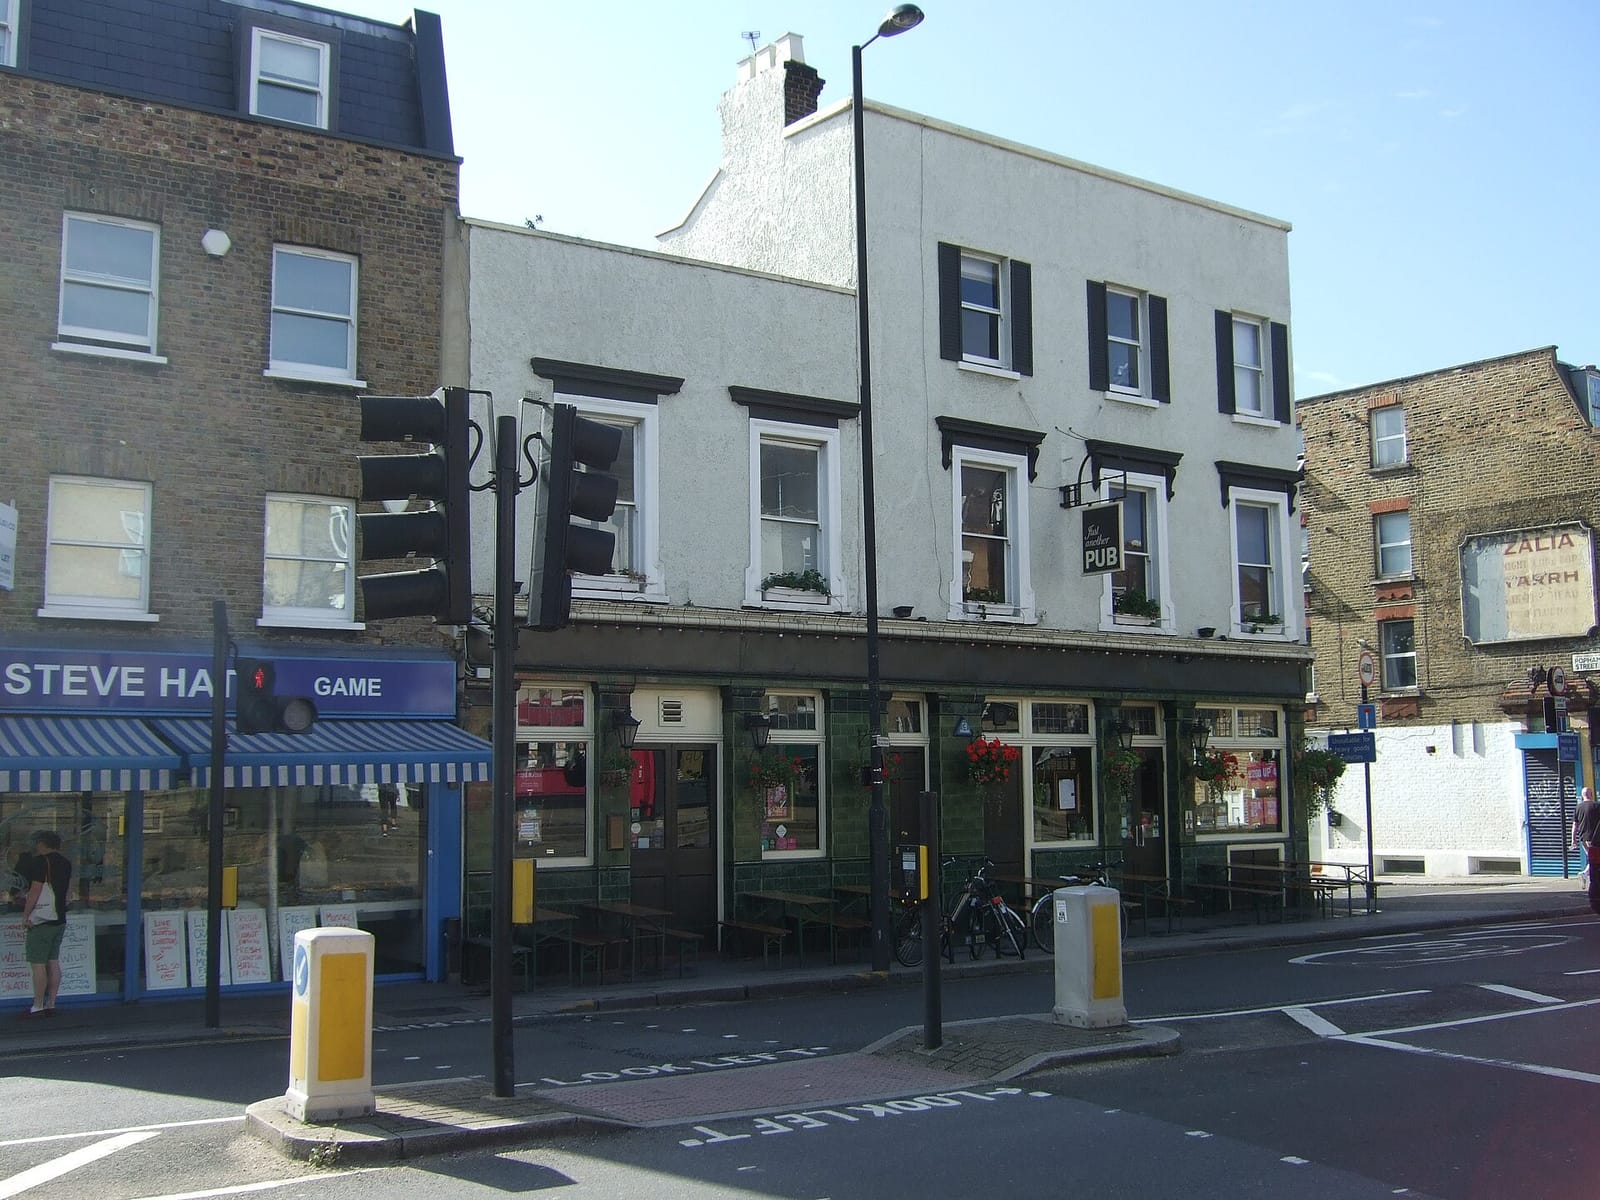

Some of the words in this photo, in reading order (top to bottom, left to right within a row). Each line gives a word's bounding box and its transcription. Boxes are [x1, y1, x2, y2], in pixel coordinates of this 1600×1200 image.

[1085, 534, 1110, 547] another
[1503, 532, 1575, 556] ZALIA
[1085, 547, 1118, 569] PUB
[1575, 662, 1599, 670] STREET
[4, 663, 145, 696] STEVE
[314, 676, 382, 697] GAME
[541, 1063, 694, 1086] LOOK
[690, 1048, 817, 1067] LEFT
[846, 1090, 996, 1117] LOOK
[693, 1109, 859, 1144] LEFT
